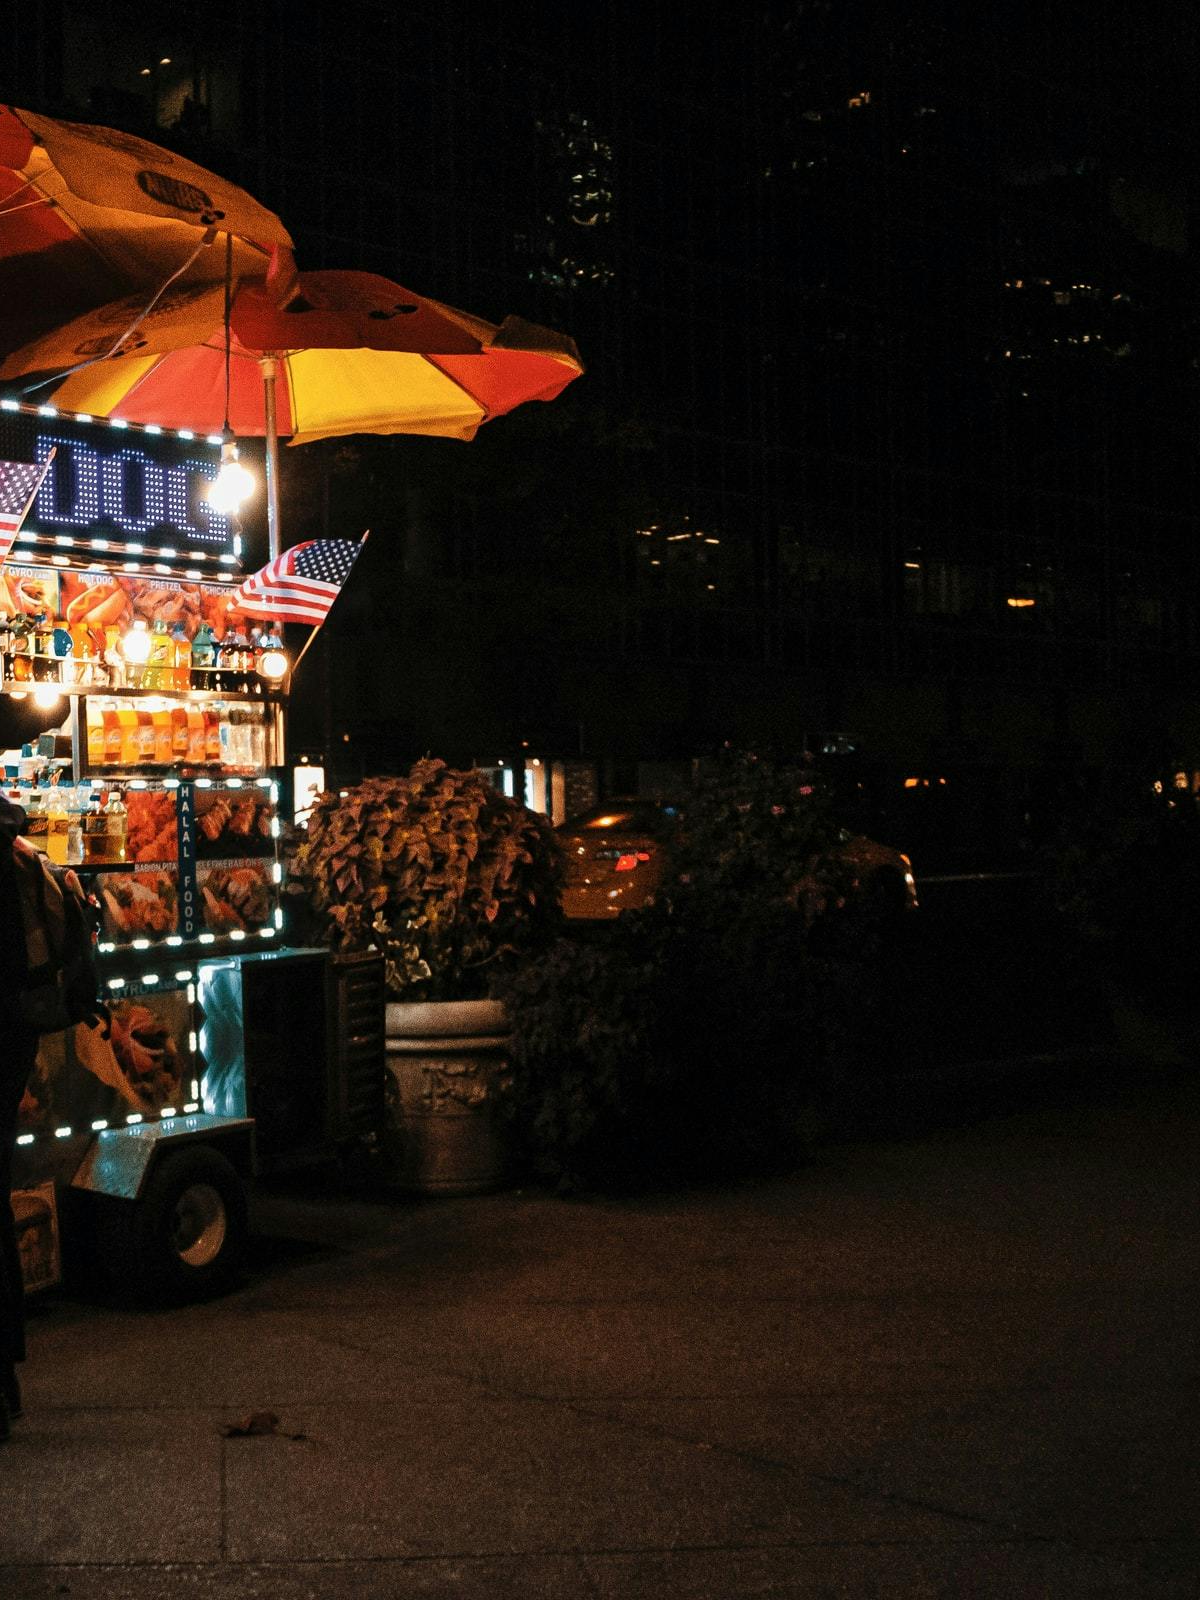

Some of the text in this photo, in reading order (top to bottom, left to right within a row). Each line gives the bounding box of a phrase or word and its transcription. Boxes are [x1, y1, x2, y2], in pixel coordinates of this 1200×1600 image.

[34, 432, 232, 545] DOG
[8, 566, 34, 578] GYRO
[77, 574, 114, 587] HOT DOG
[150, 580, 182, 592] PRETZEL
[180, 786, 194, 932] HALAL FOOD
